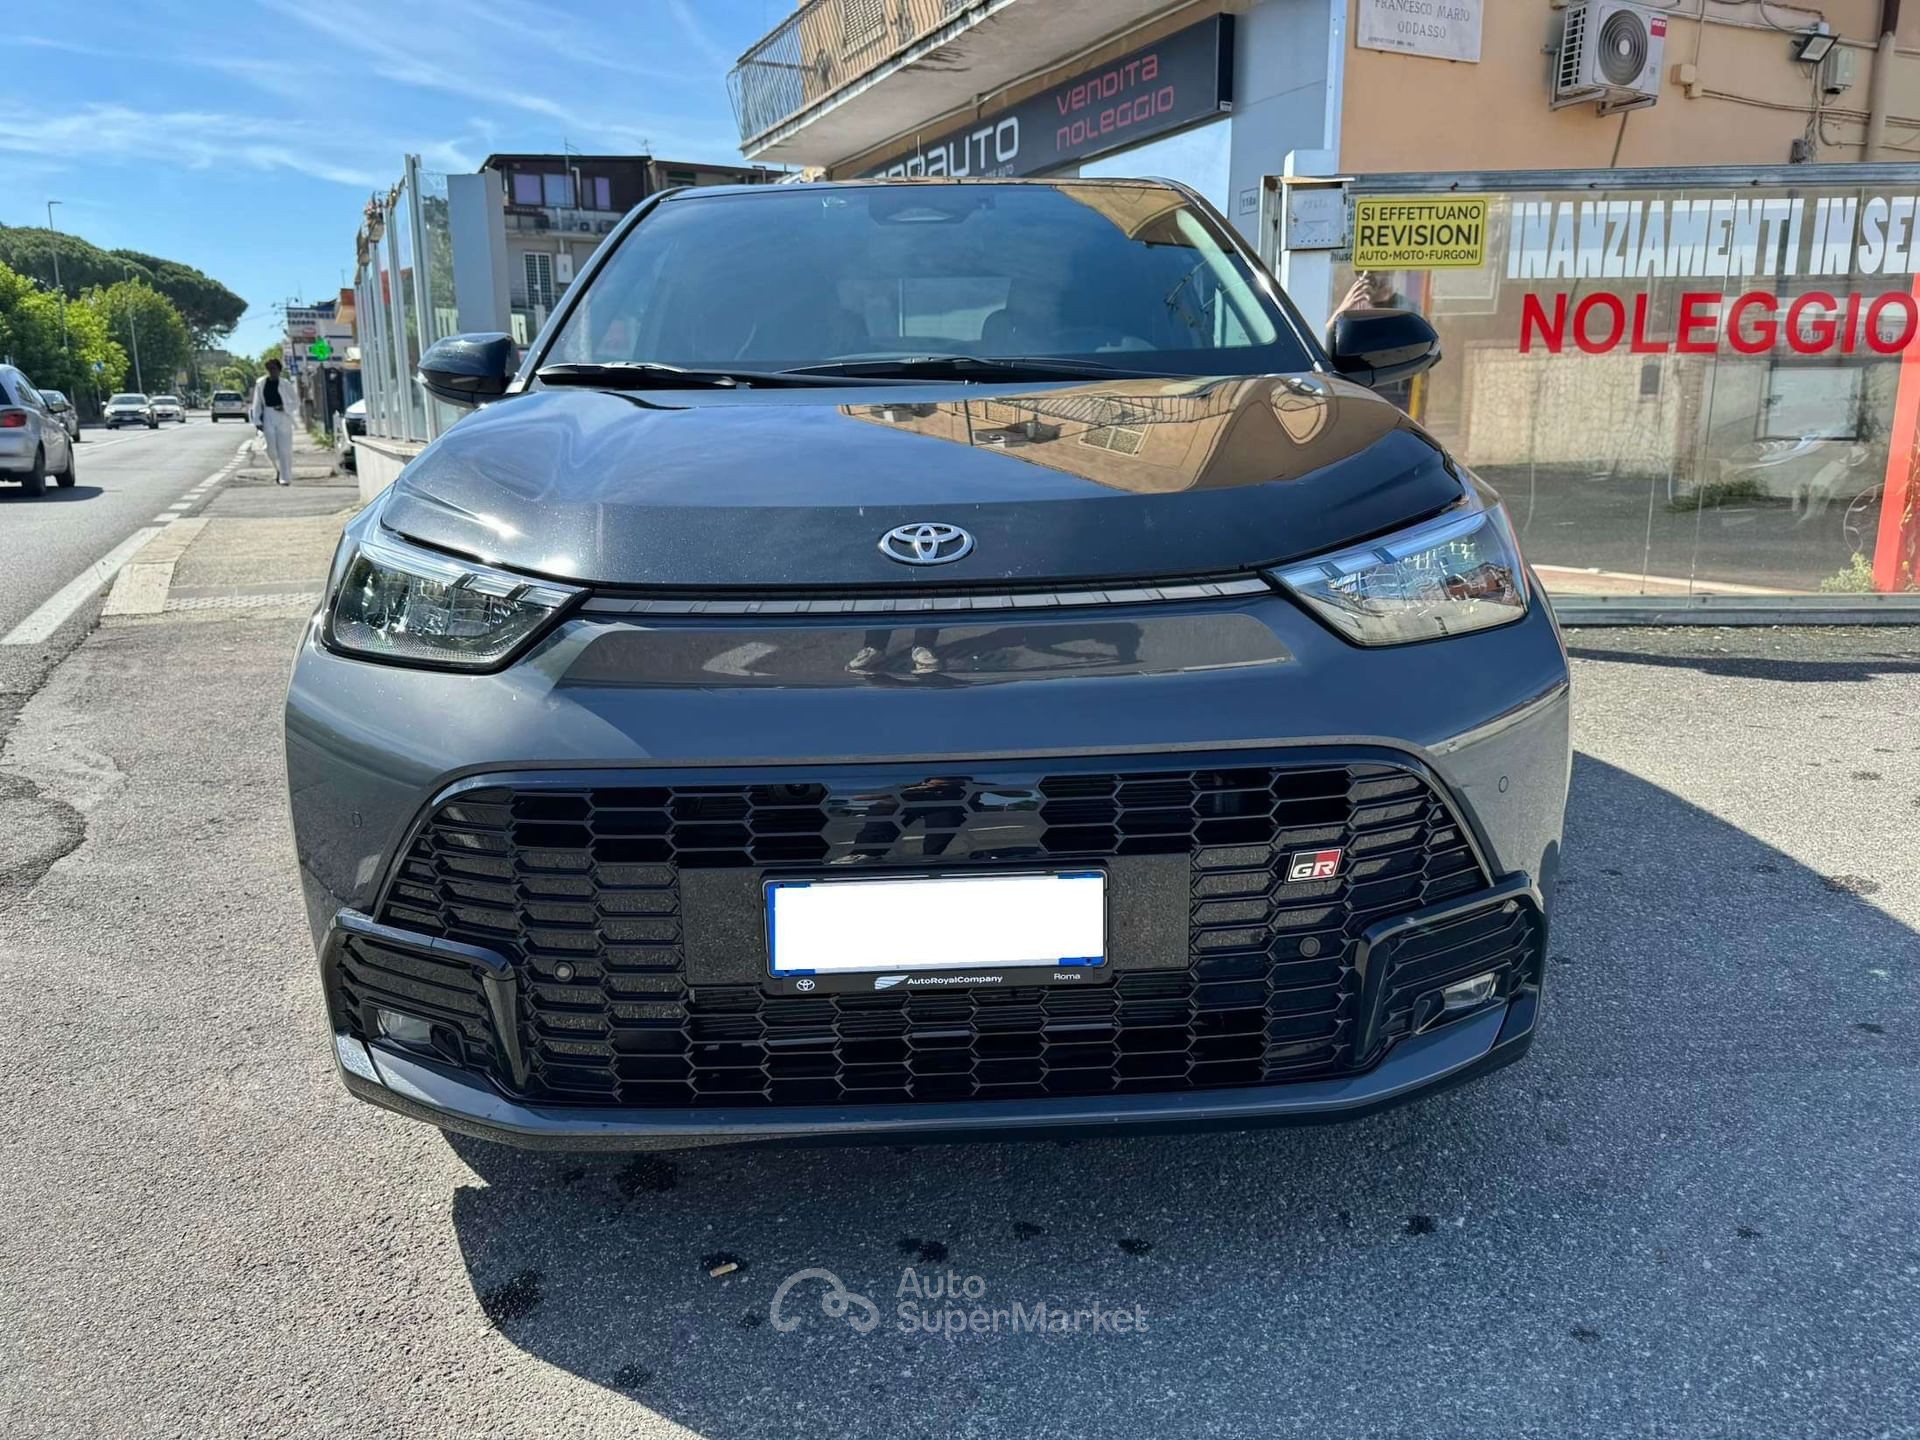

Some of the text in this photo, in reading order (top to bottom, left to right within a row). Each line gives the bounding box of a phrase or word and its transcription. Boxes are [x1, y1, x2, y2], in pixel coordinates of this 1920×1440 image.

[1437, 6, 1470, 21] MARIO
[1397, 21, 1446, 38] ODDASSO
[1361, 206, 1480, 221] SI EFFETTUANO
[1360, 224, 1480, 246] REVISIONI
[1519, 291, 1919, 355] NOLEGGIO
[1292, 861, 1335, 878] GR
[907, 972, 1081, 986] AutoRoyalCompany Roma
